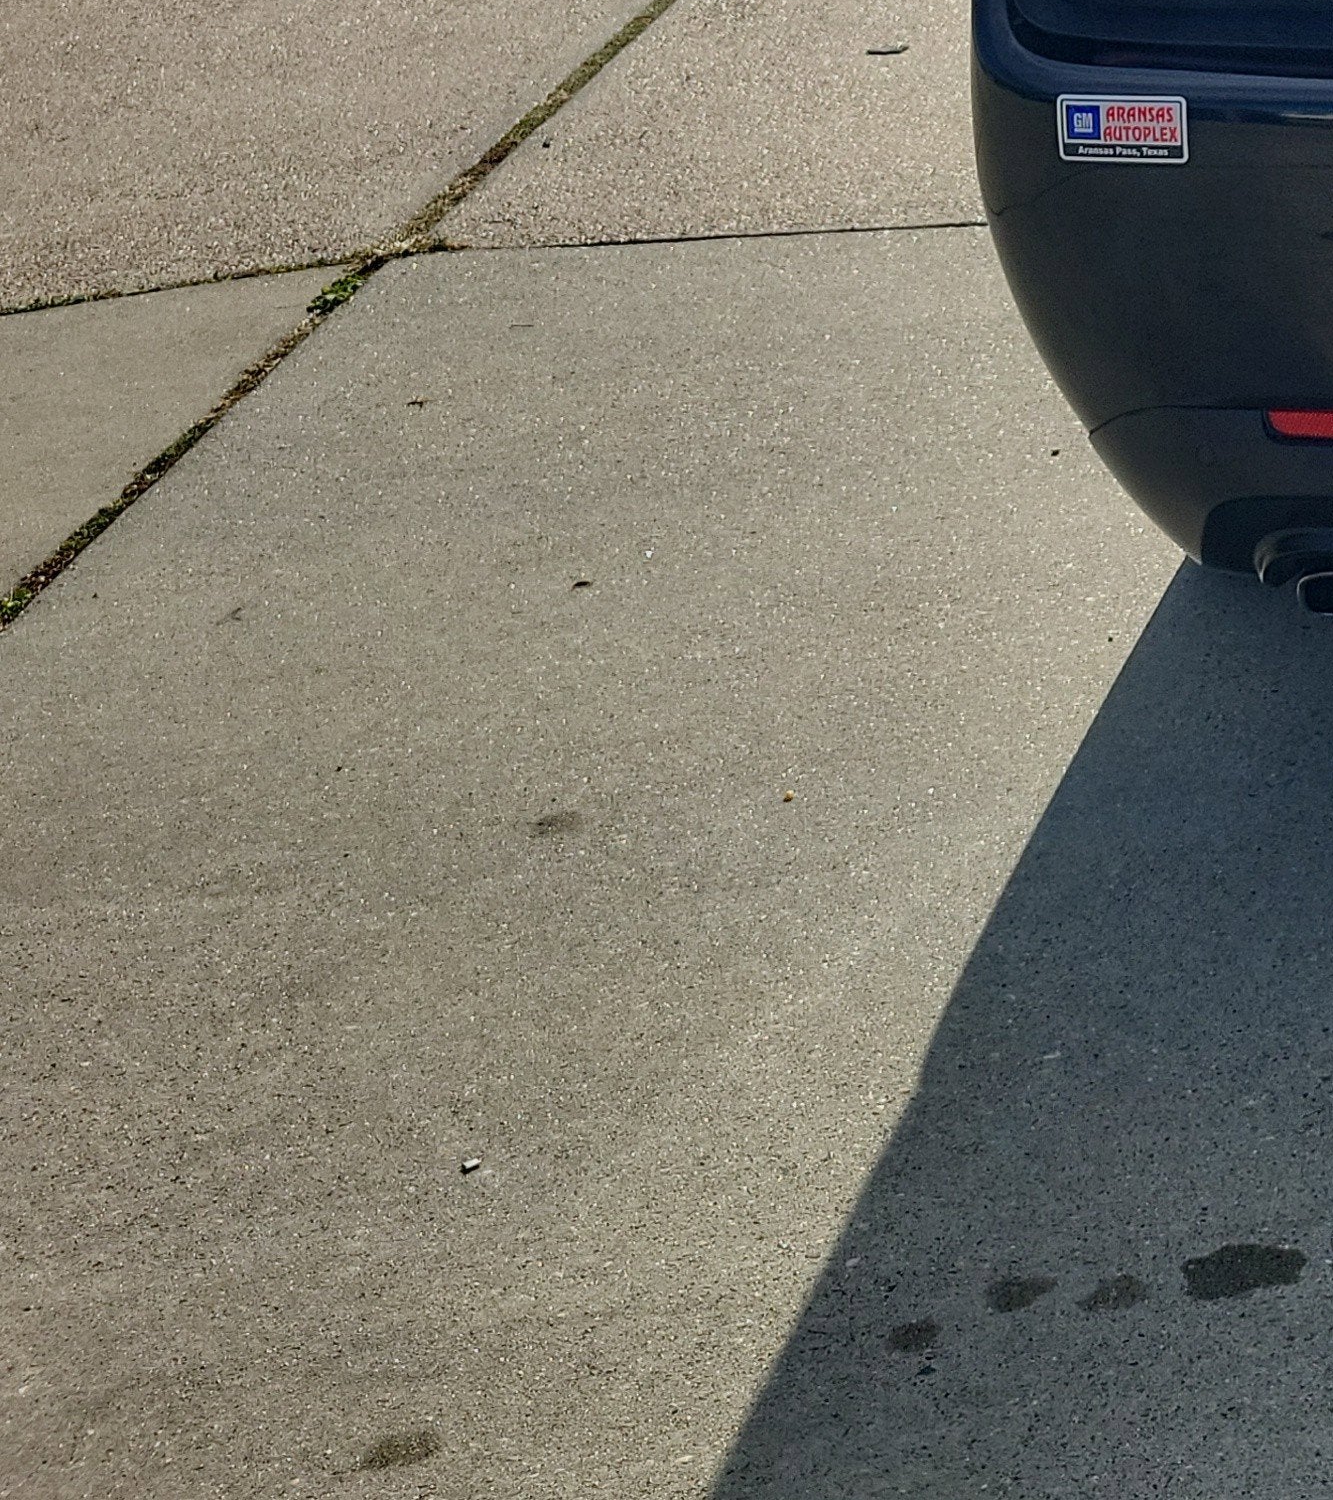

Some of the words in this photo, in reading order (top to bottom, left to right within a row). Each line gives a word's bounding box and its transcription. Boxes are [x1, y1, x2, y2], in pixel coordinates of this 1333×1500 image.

[1073, 112, 1094, 134] GM
[1105, 105, 1175, 124] ARANSAS
[1103, 125, 1179, 143] AUTOPLEX
[1078, 145, 1114, 156] Aransas
[1115, 146, 1141, 157] Pass,
[1142, 147, 1169, 157] Texas
